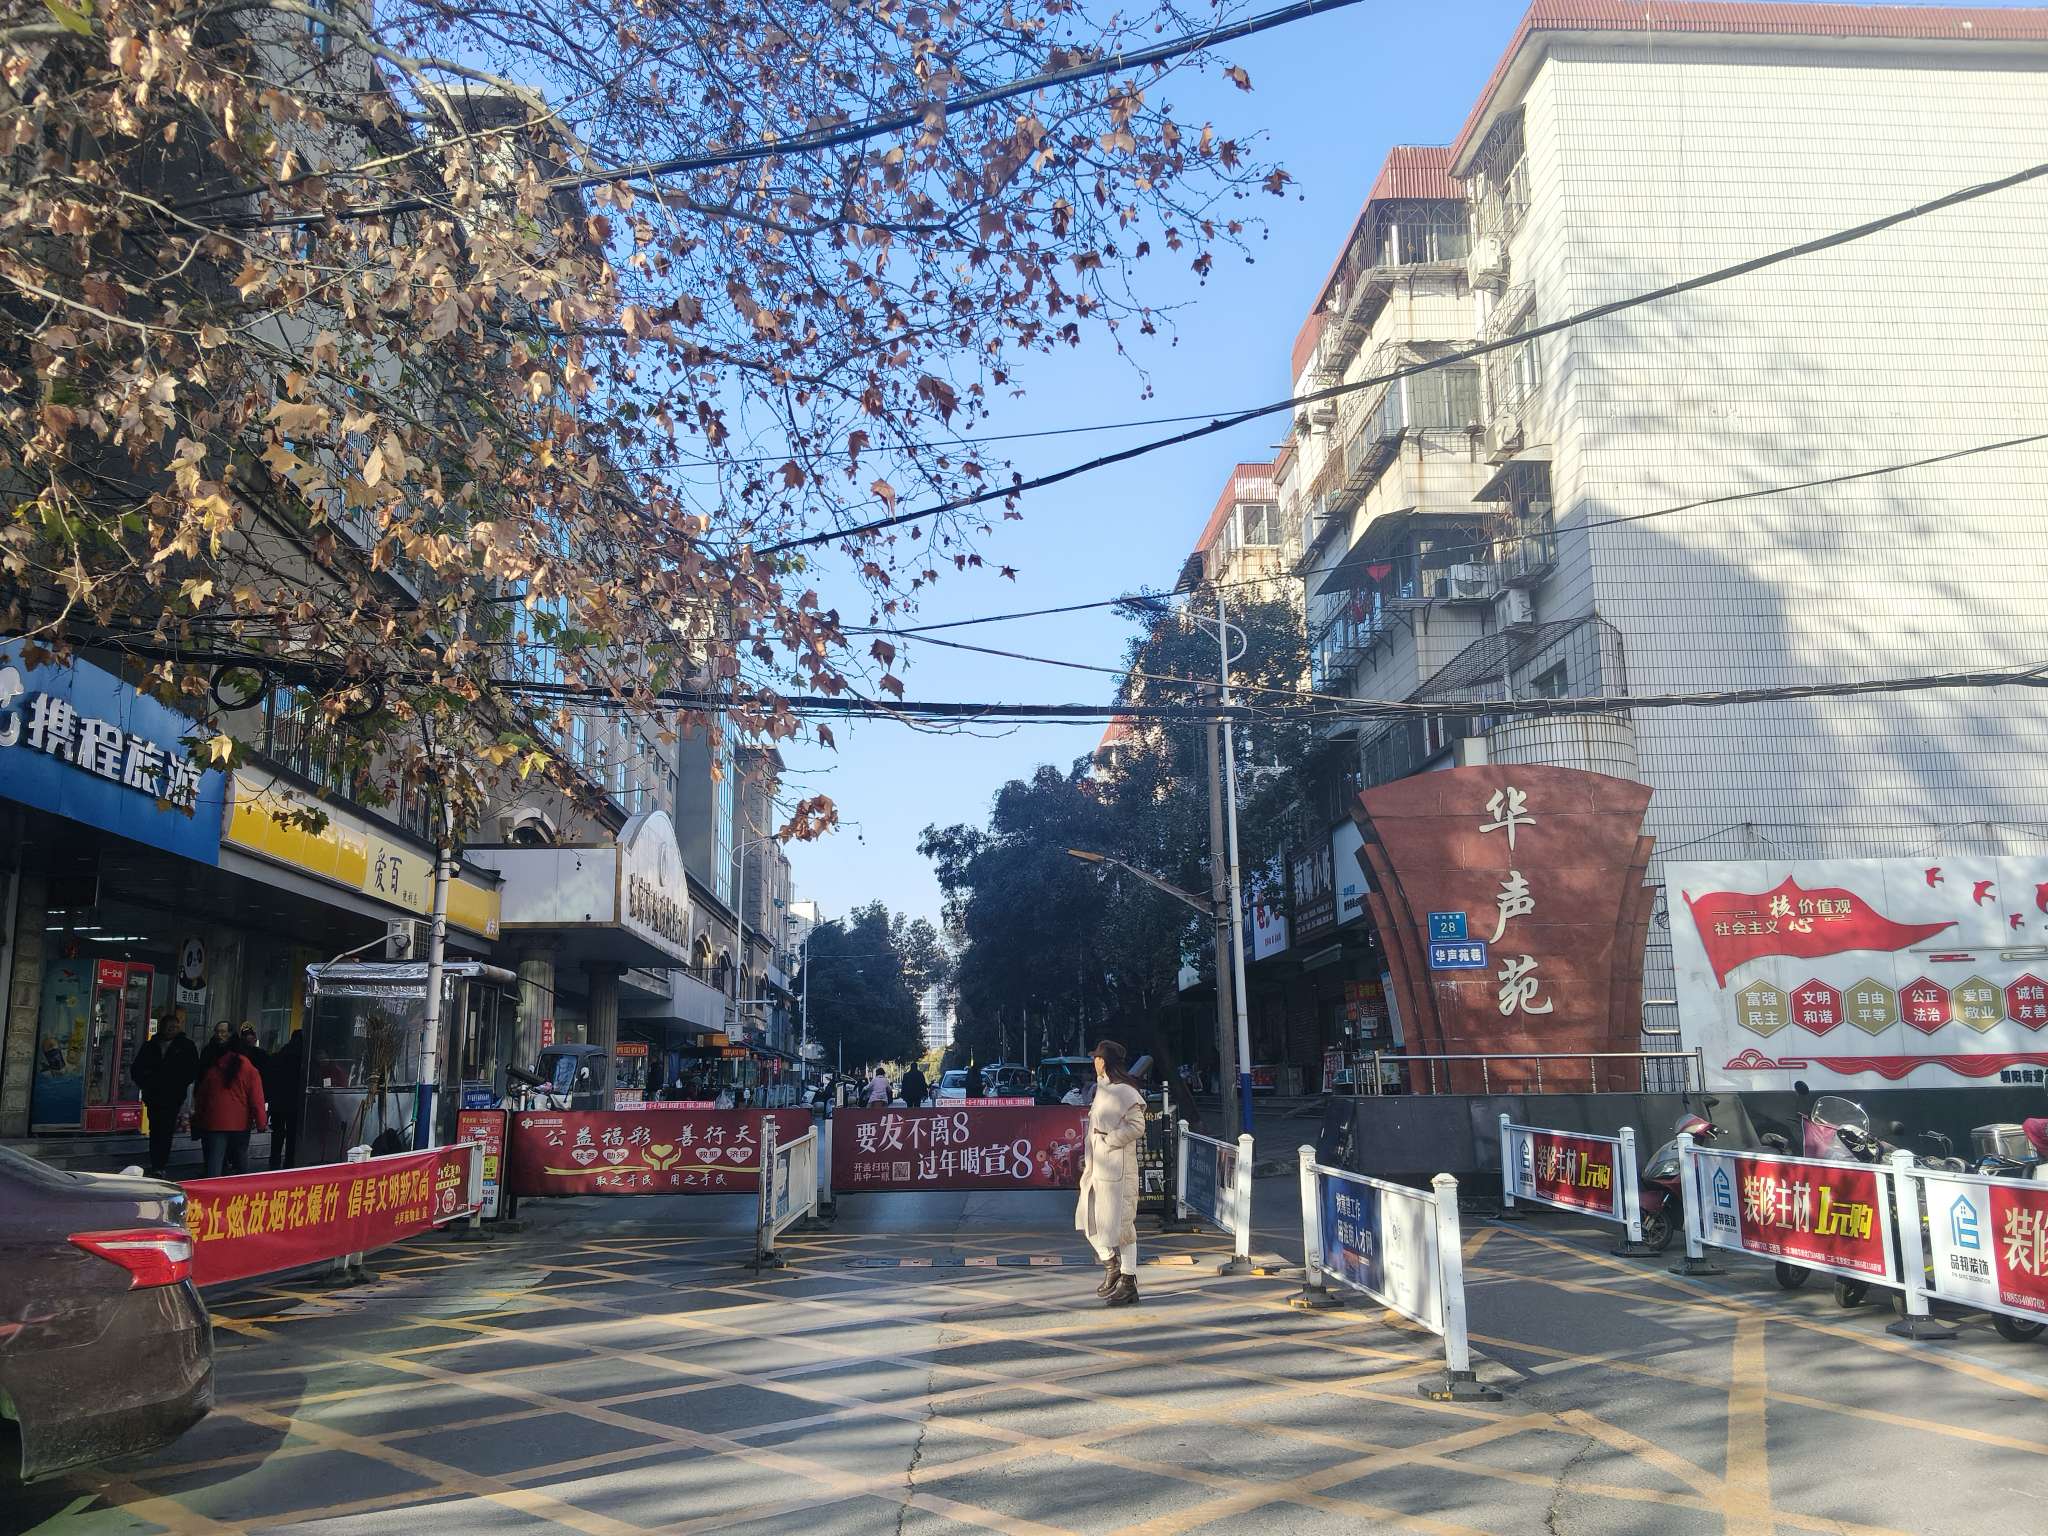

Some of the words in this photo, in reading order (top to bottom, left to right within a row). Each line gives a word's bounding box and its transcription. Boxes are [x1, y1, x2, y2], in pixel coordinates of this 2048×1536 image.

[28, 693, 200, 809] 携程旅游
[374, 848, 403, 895] 爱百
[1480, 787, 1553, 1016] 华声苑
[1714, 920, 1780, 936] 社会主义
[1798, 899, 1852, 914] 价值观
[1440, 922, 1456, 933] 28
[1435, 948, 1481, 962] 华声苑巷
[1745, 991, 1778, 1007] 富强
[1801, 991, 1831, 1006] 文明
[1857, 991, 1884, 1005] 自由
[1911, 989, 1938, 1003] 公正
[1962, 988, 1992, 1002] 爱国
[2015, 986, 2045, 1000] 诚信
[1748, 1011, 1780, 1026] 民主
[1803, 1010, 1833, 1025] 和谐
[1858, 1008, 1887, 1022] 平等
[1913, 1007, 1940, 1022] 法治
[1964, 1005, 1995, 1020] 敬业
[2019, 1004, 2047, 1019] 友善
[2000, 1069, 2048, 1084] 朝阳街道
[544, 1126, 651, 1148] 公益福彩
[855, 1111, 970, 1154] 要发不离8
[917, 1139, 1033, 1180] 过年喝宣8
[1538, 1145, 1577, 1185] 装修主材
[1578, 1152, 1611, 1190] 1元购
[186, 1183, 340, 1243] 禁止燃放烟花爆竹
[347, 1168, 430, 1218] 倡导文明新风尚
[1743, 1175, 1811, 1233] 装修主材
[1814, 1186, 1874, 1240] 1元购
